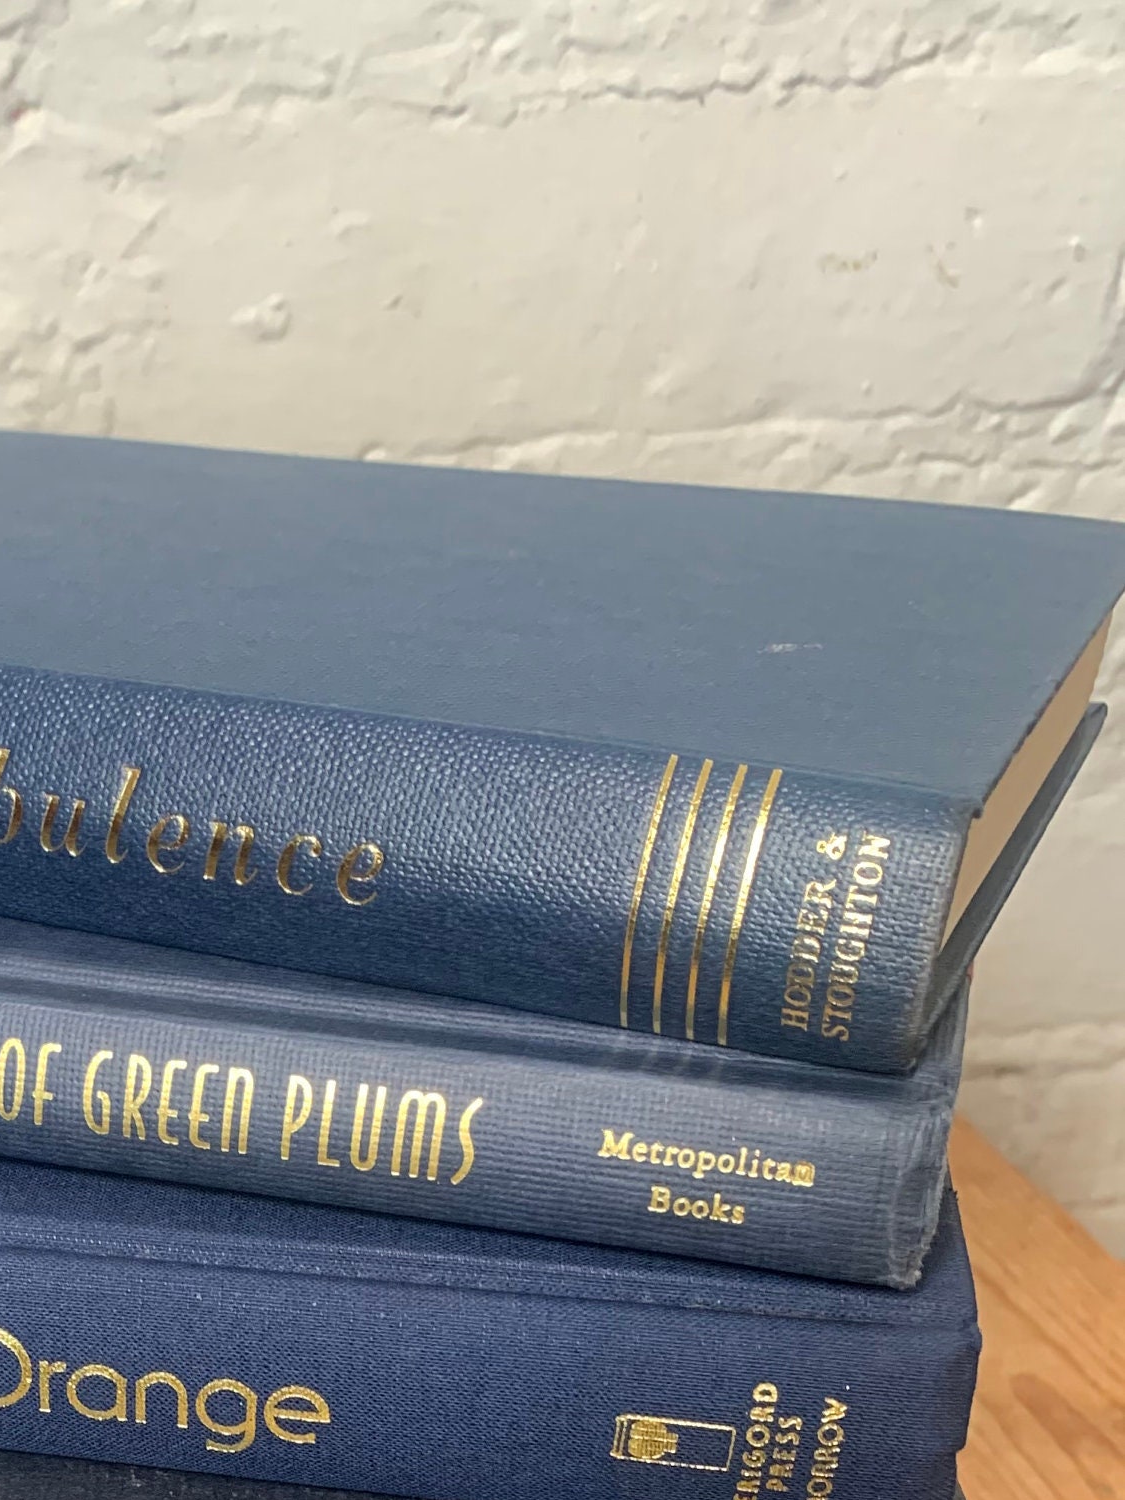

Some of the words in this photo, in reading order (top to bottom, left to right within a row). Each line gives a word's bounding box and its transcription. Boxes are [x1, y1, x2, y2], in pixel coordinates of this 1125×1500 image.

[780, 878, 837, 1032] HODDER
[816, 830, 849, 861] &
[820, 829, 893, 1042] STOUGHTON
[81, 1048, 256, 1155] GREEN
[279, 1073, 485, 1186] PLUMS
[596, 1128, 817, 1188] Metropolitan
[646, 1185, 747, 1225] Books
[765, 1415, 804, 1493] PRESS
